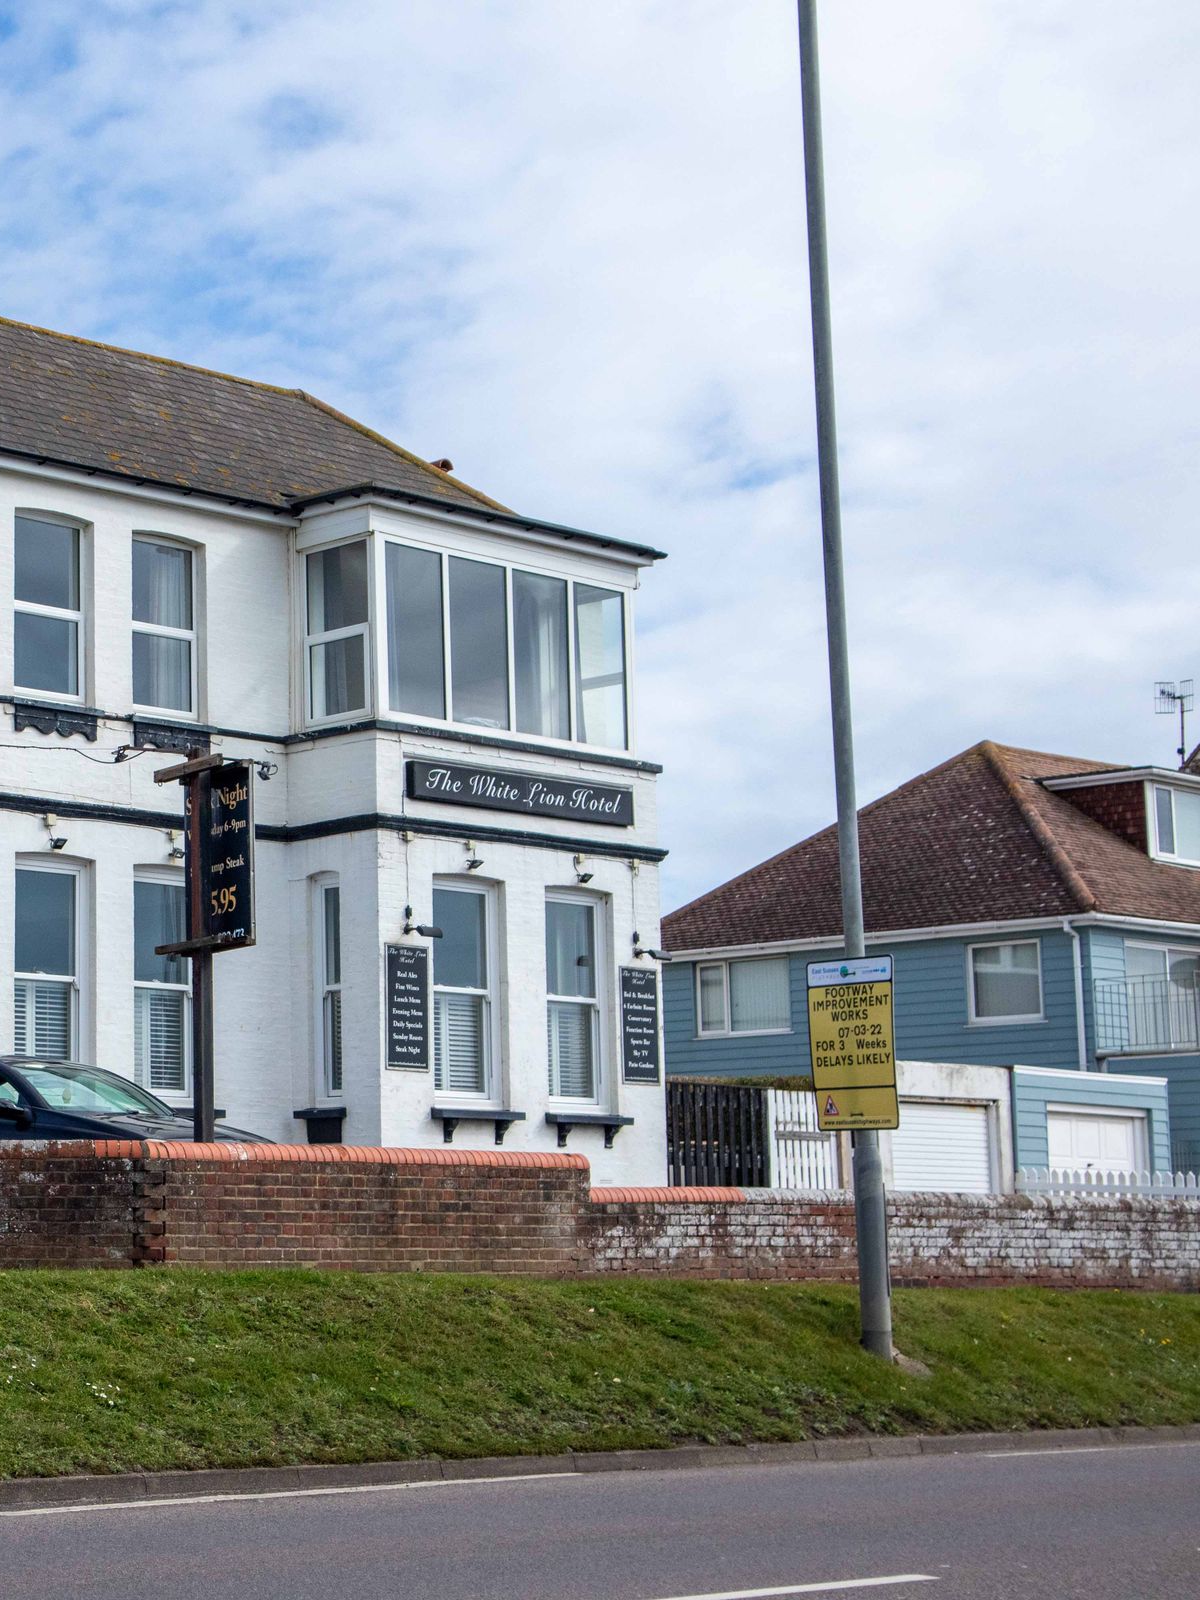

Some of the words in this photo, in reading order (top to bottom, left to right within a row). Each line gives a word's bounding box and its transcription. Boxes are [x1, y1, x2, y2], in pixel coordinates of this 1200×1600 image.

[216, 782, 248, 809] Night
[426, 768, 463, 792] The
[469, 774, 520, 801] White
[523, 781, 567, 807] Lion
[570, 788, 622, 814] Hotel
[224, 819, 246, 833] 6-9pm
[211, 863, 224, 875] ump
[226, 854, 245, 869] Steak
[825, 984, 875, 999] FOOTWAY
[813, 994, 889, 1012] IMPROVEMENT
[831, 1009, 869, 1022] WORKS
[816, 1040, 836, 1052] FOR
[839, 1039, 845, 1051] 3
[855, 1038, 887, 1050] Weeks
[816, 1054, 854, 1067] DELAYS
[856, 1052, 891, 1065] LIKELY
